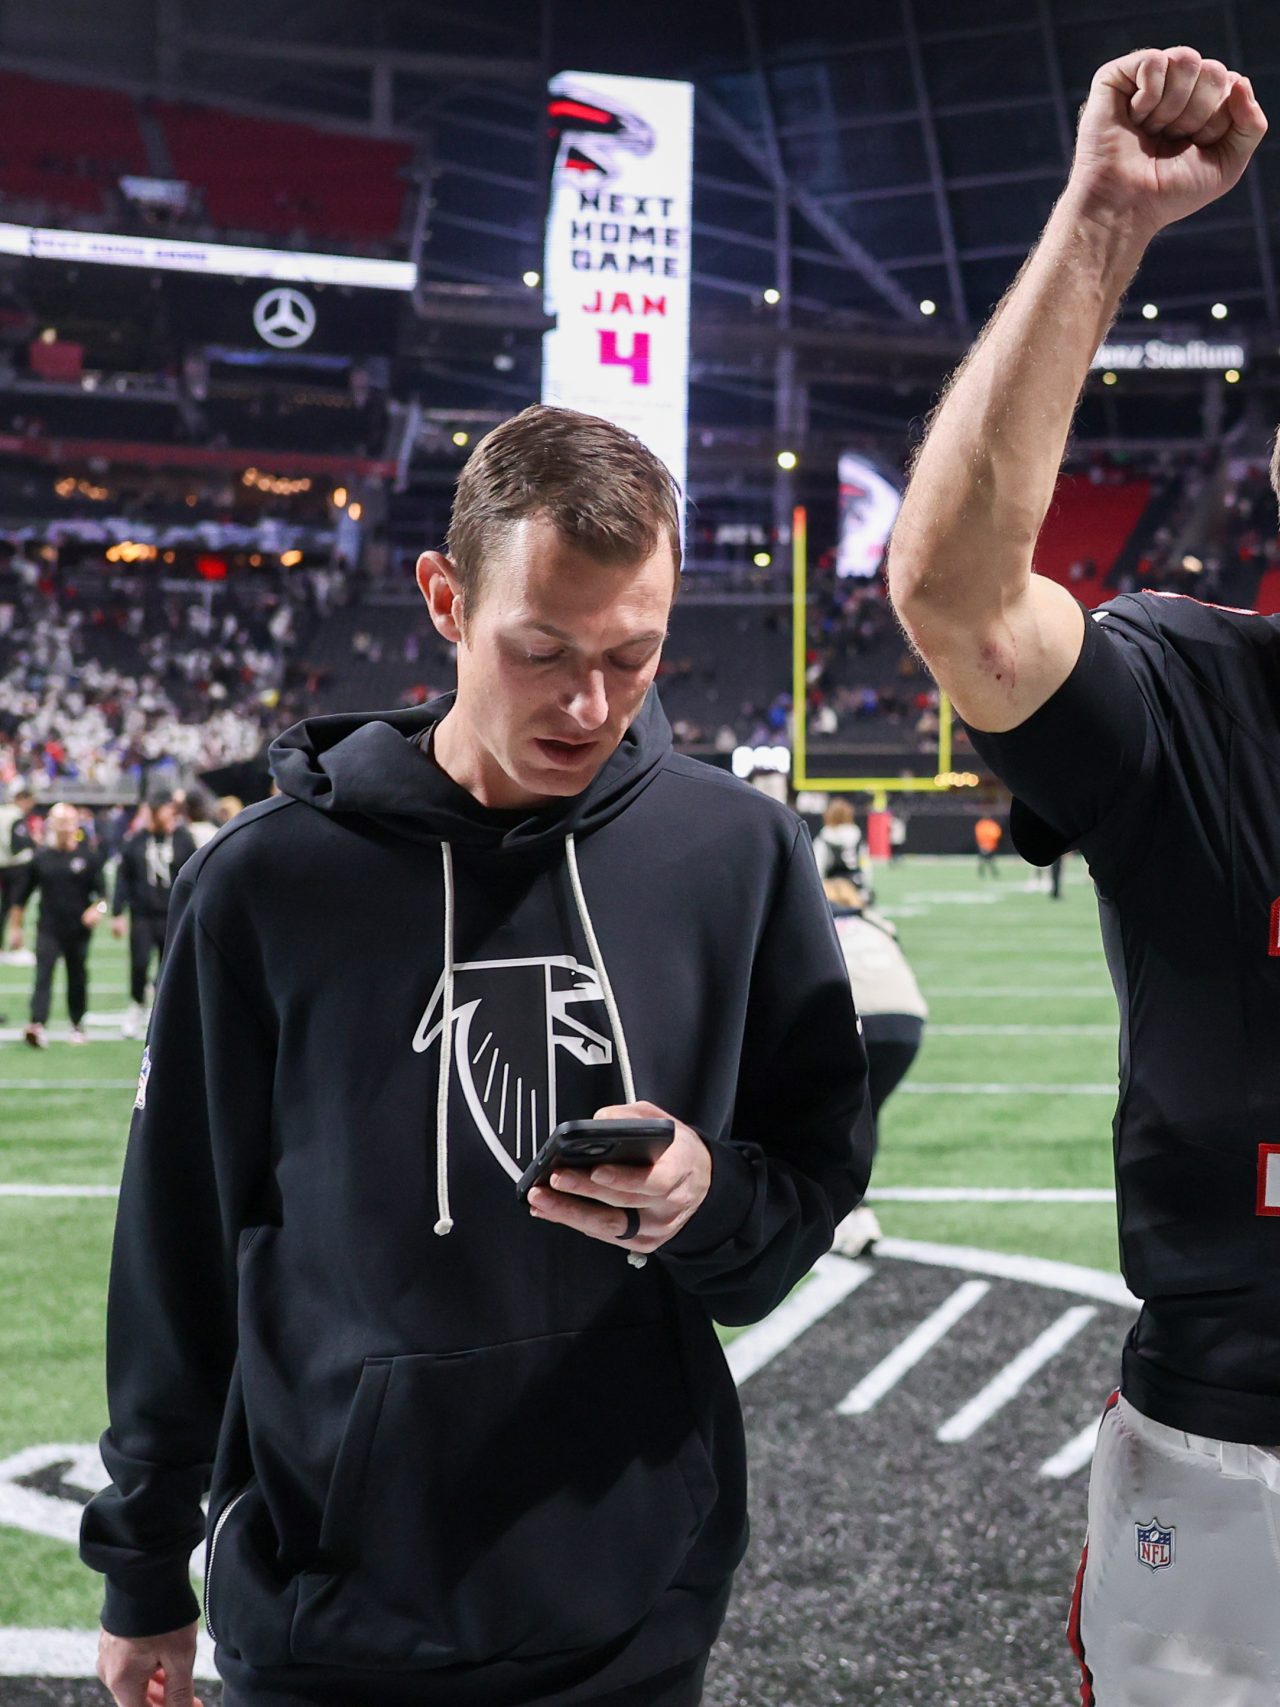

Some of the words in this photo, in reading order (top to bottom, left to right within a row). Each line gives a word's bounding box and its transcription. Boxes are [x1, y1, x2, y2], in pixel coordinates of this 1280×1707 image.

[579, 190, 674, 218] NEXT
[571, 220, 679, 247] HOME
[571, 249, 678, 278] GAME
[582, 289, 667, 317] JAN
[597, 328, 651, 386] 4
[1144, 339, 1245, 369] Stadium
[1141, 1542, 1168, 1564] NFL
